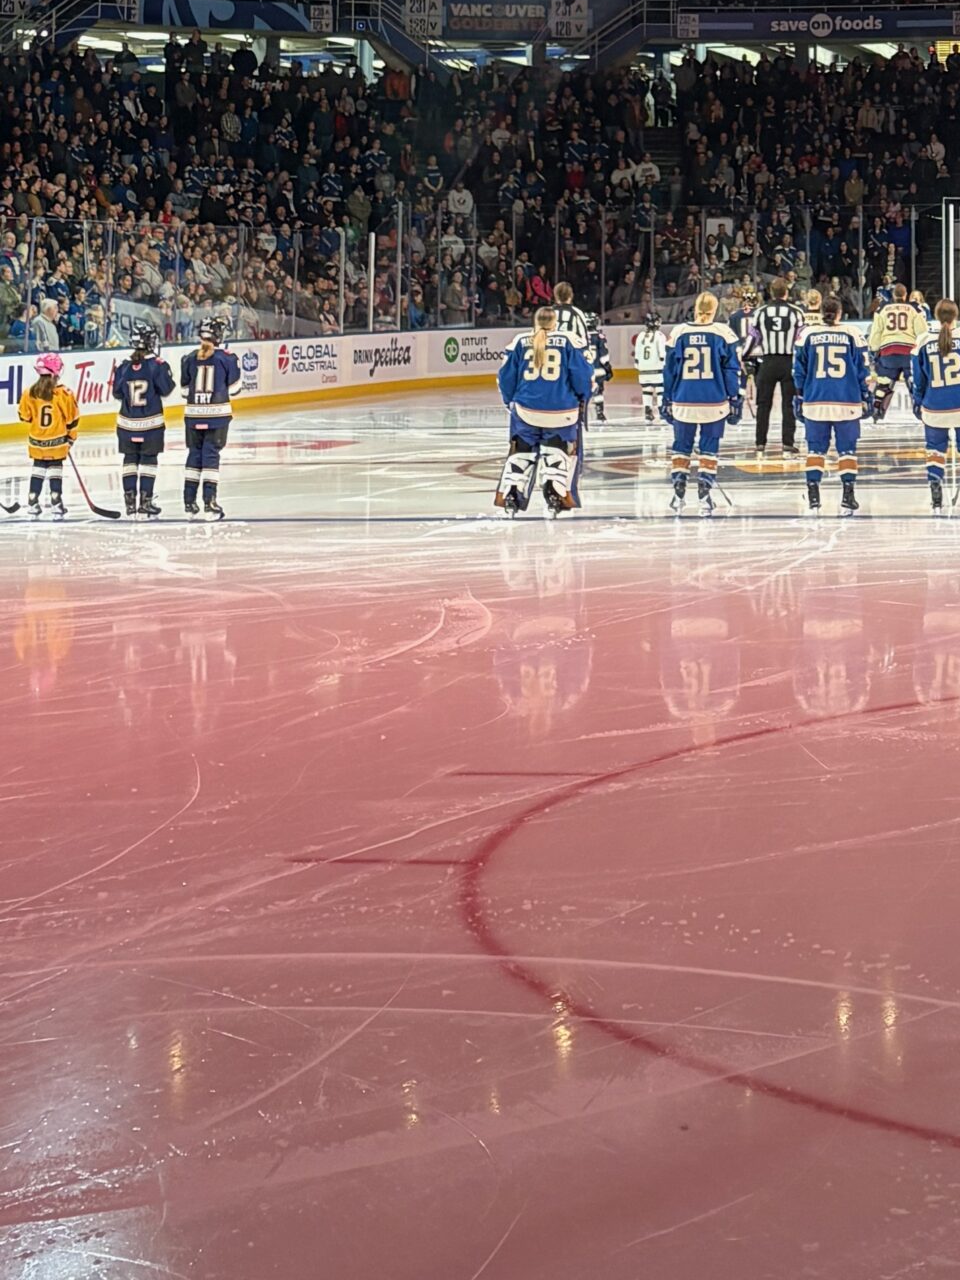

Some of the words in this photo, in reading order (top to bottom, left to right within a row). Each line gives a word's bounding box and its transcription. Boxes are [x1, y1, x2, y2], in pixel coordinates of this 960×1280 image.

[450, 3, 546, 18] VANCOUVER
[770, 20, 808, 32] save
[811, 19, 831, 30] on
[835, 15, 883, 31] foods
[773, 318, 782, 331] 3
[886, 312, 909, 331] 30
[461, 337, 488, 347] INTUIT
[690, 334, 708, 344] BELL
[292, 344, 338, 361] GLOBAL
[353, 349, 373, 365] DRINK
[460, 348, 508, 366] quickboo
[644, 347, 651, 361] 6
[292, 360, 338, 373] INDUSTRIAL
[523, 348, 562, 382] 38
[683, 344, 714, 380] 21
[816, 345, 848, 379] 15
[75, 361, 104, 405] Tim
[195, 365, 215, 393] 11
[127, 380, 149, 408] 12
[195, 393, 212, 404] FRY
[40, 405, 53, 427] 6
